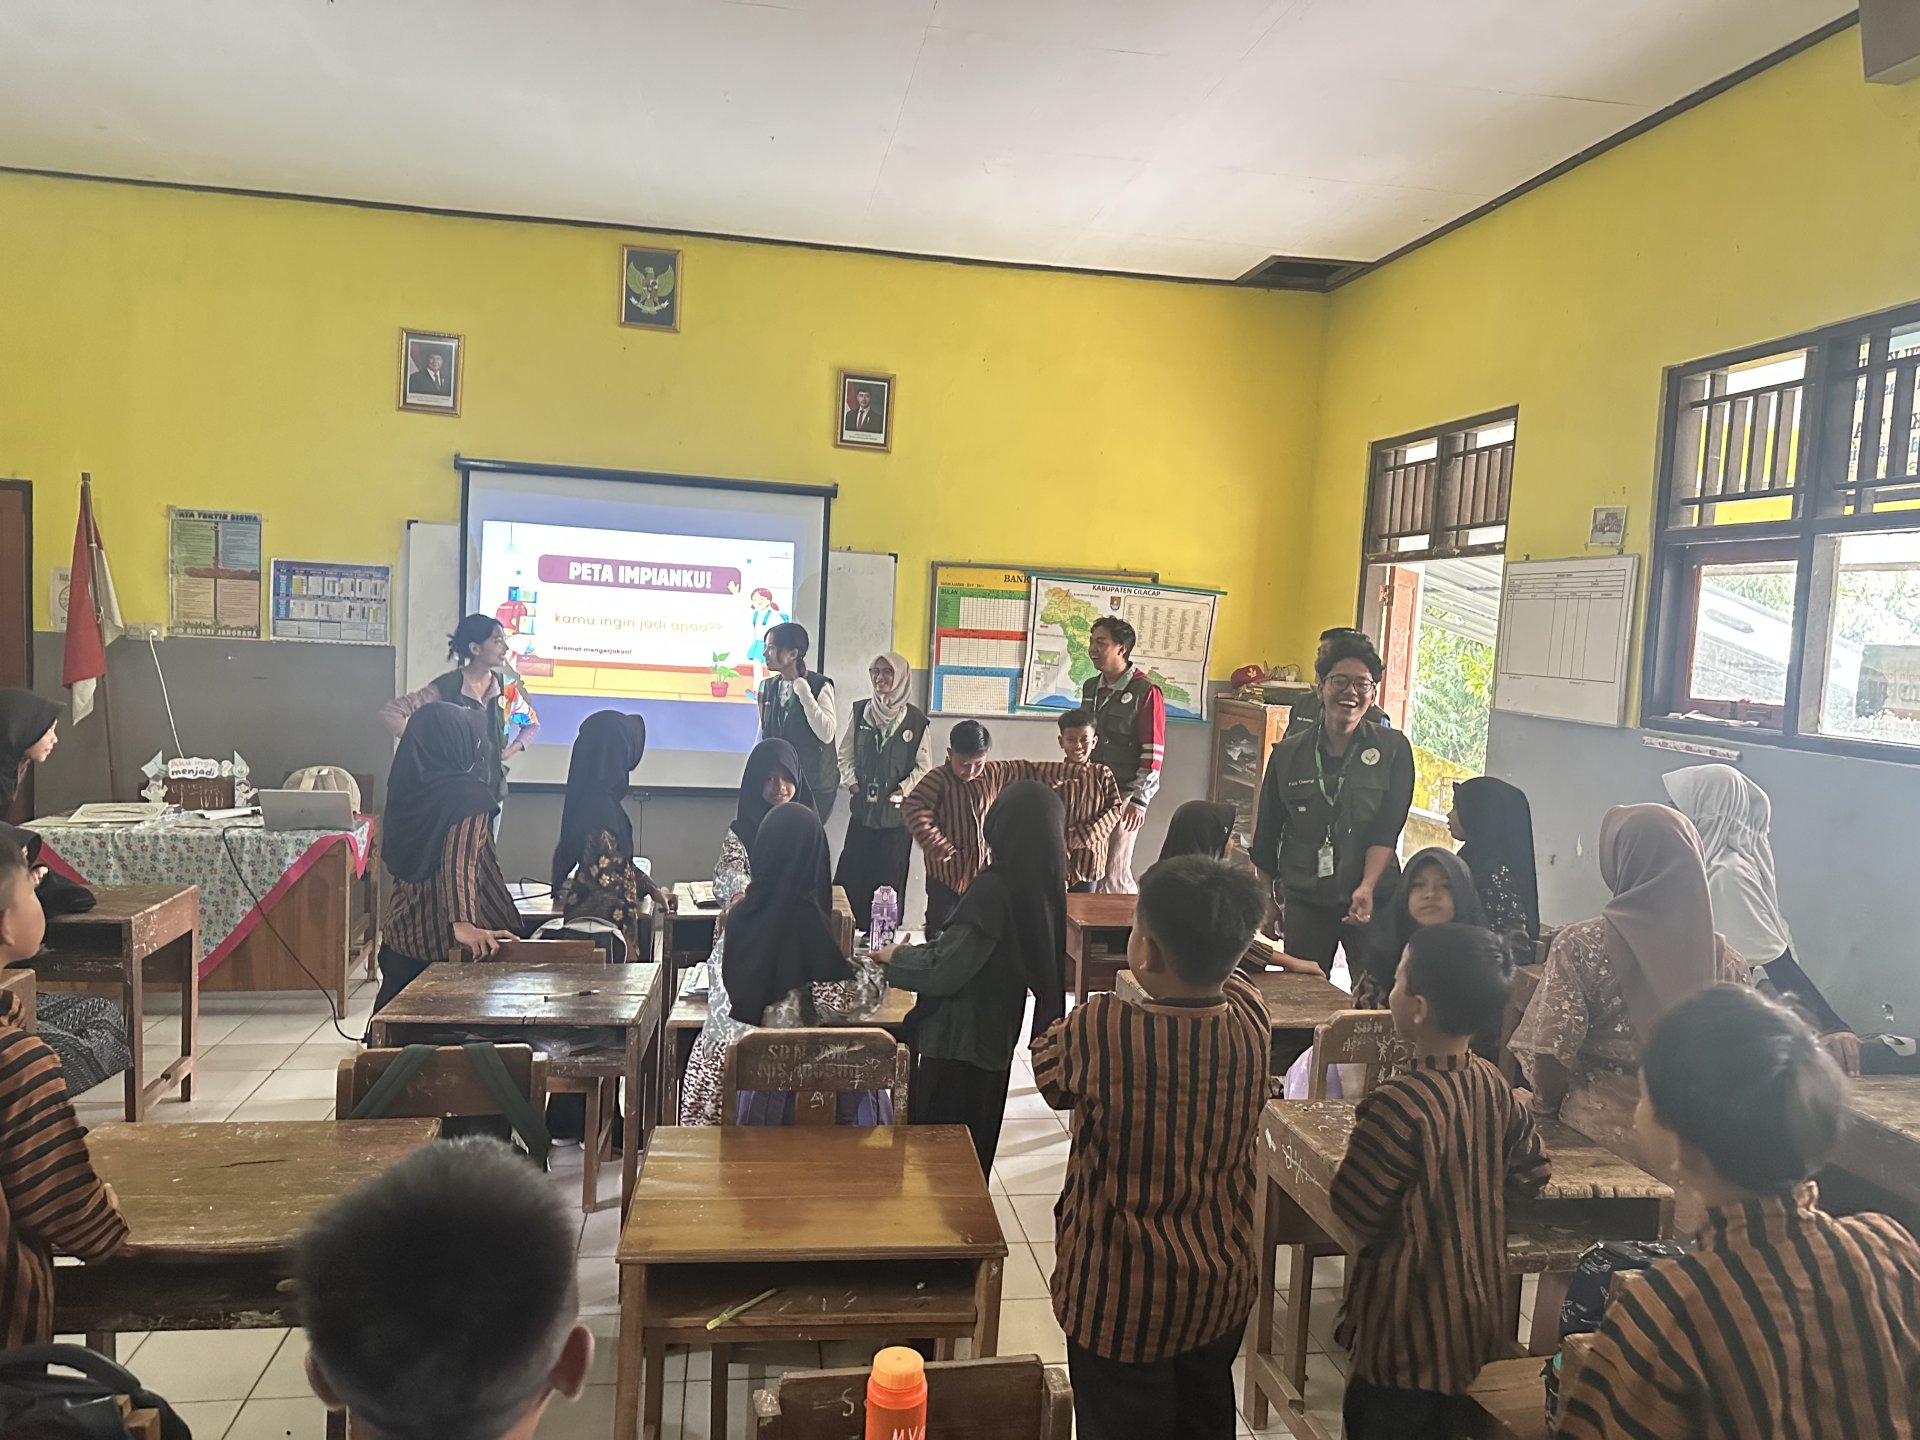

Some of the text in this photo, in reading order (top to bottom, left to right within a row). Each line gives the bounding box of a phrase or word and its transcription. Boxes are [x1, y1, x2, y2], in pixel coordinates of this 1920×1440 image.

[230, 513, 259, 521] SISWA
[568, 562, 713, 589] PETA IMPIANKU!
[940, 588, 958, 596] BULAN
[1092, 584, 1161, 597] KABUPATEN CILACAP
[554, 613, 595, 626] kamu
[600, 616, 635, 631] ingin
[640, 618, 666, 632] jadi
[553, 645, 632, 656] Selamat mengerjakan!
[171, 765, 215, 777] menjadi
